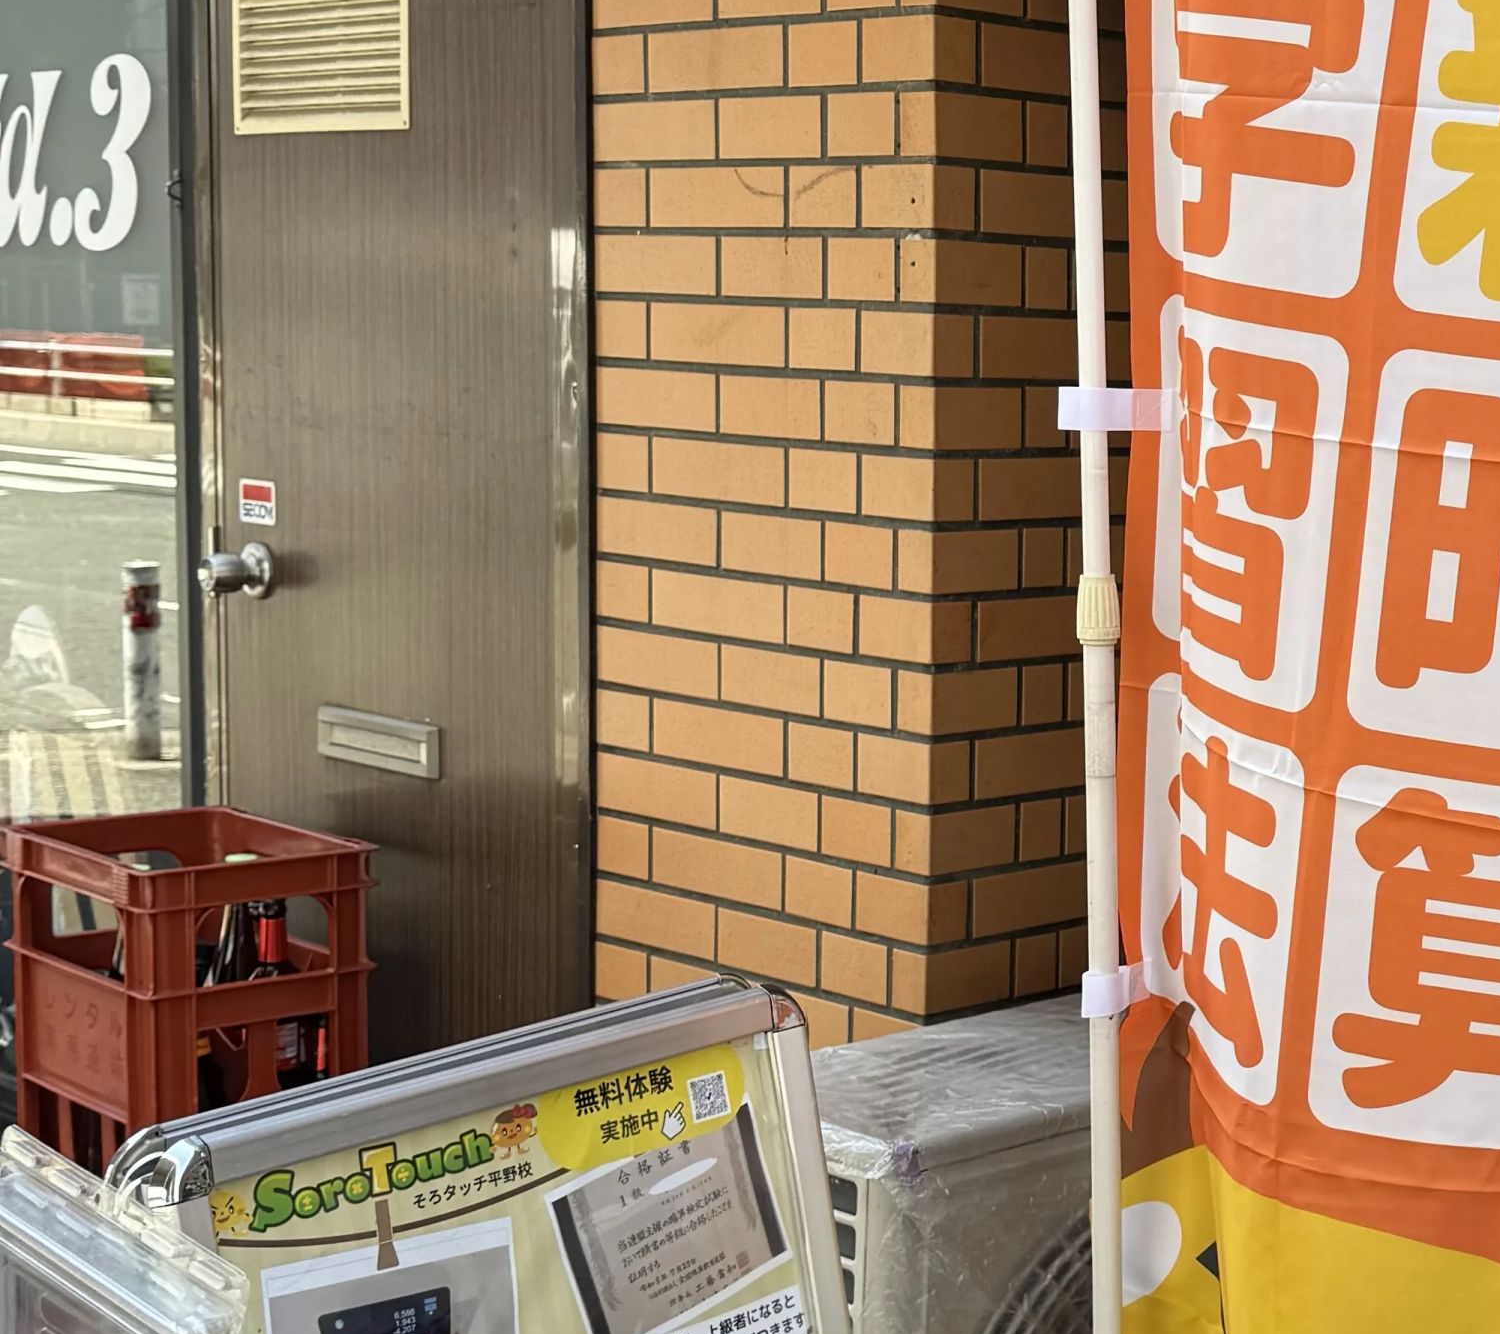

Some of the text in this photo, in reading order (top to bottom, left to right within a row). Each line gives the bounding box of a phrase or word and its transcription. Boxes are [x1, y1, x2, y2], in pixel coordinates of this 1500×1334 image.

[574, 1065, 674, 1117] 無料体験
[600, 1108, 660, 1144] 実施中
[249, 1128, 495, 1233] SoroTouch
[413, 1161, 534, 1210] そろタッチ平野校
[617, 1139, 691, 1186] 合格証書
